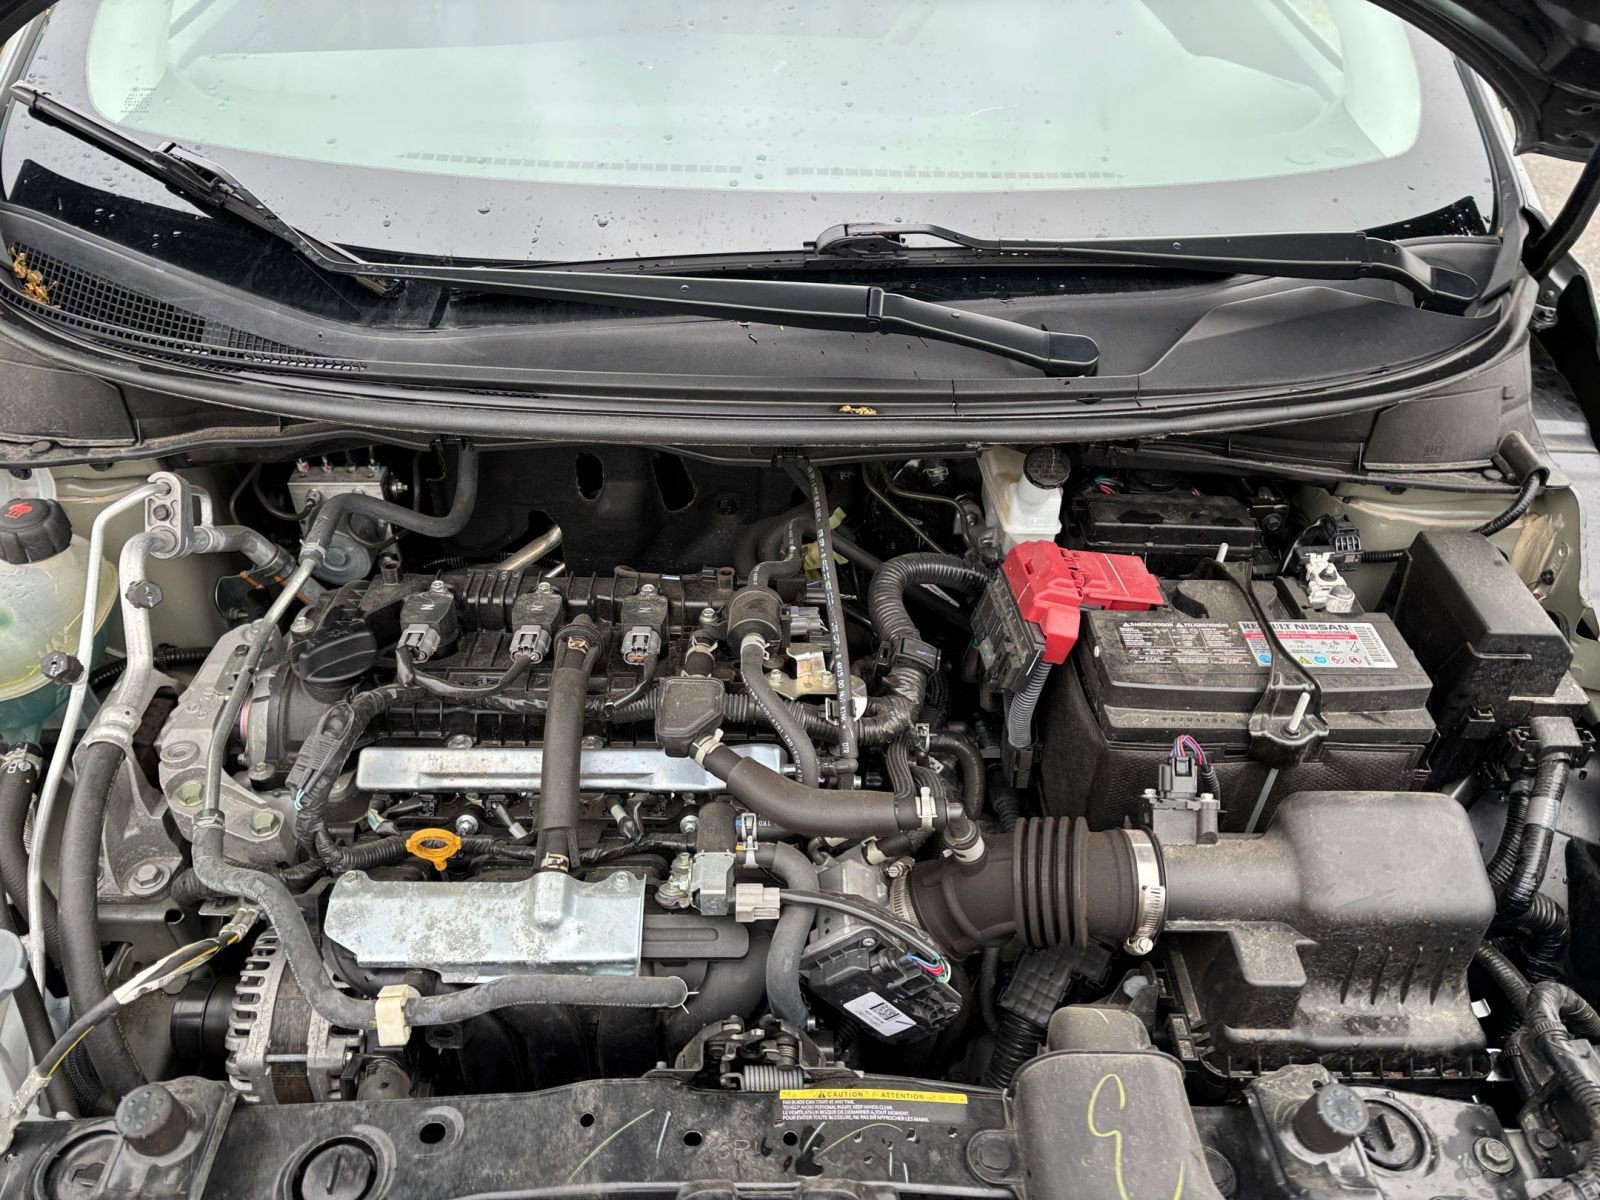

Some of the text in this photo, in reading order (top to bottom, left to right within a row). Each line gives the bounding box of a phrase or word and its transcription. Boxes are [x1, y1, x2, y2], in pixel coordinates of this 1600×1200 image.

[1241, 622, 1350, 631] REULT NISSAN
[881, 1092, 924, 1100] ATTENTION
